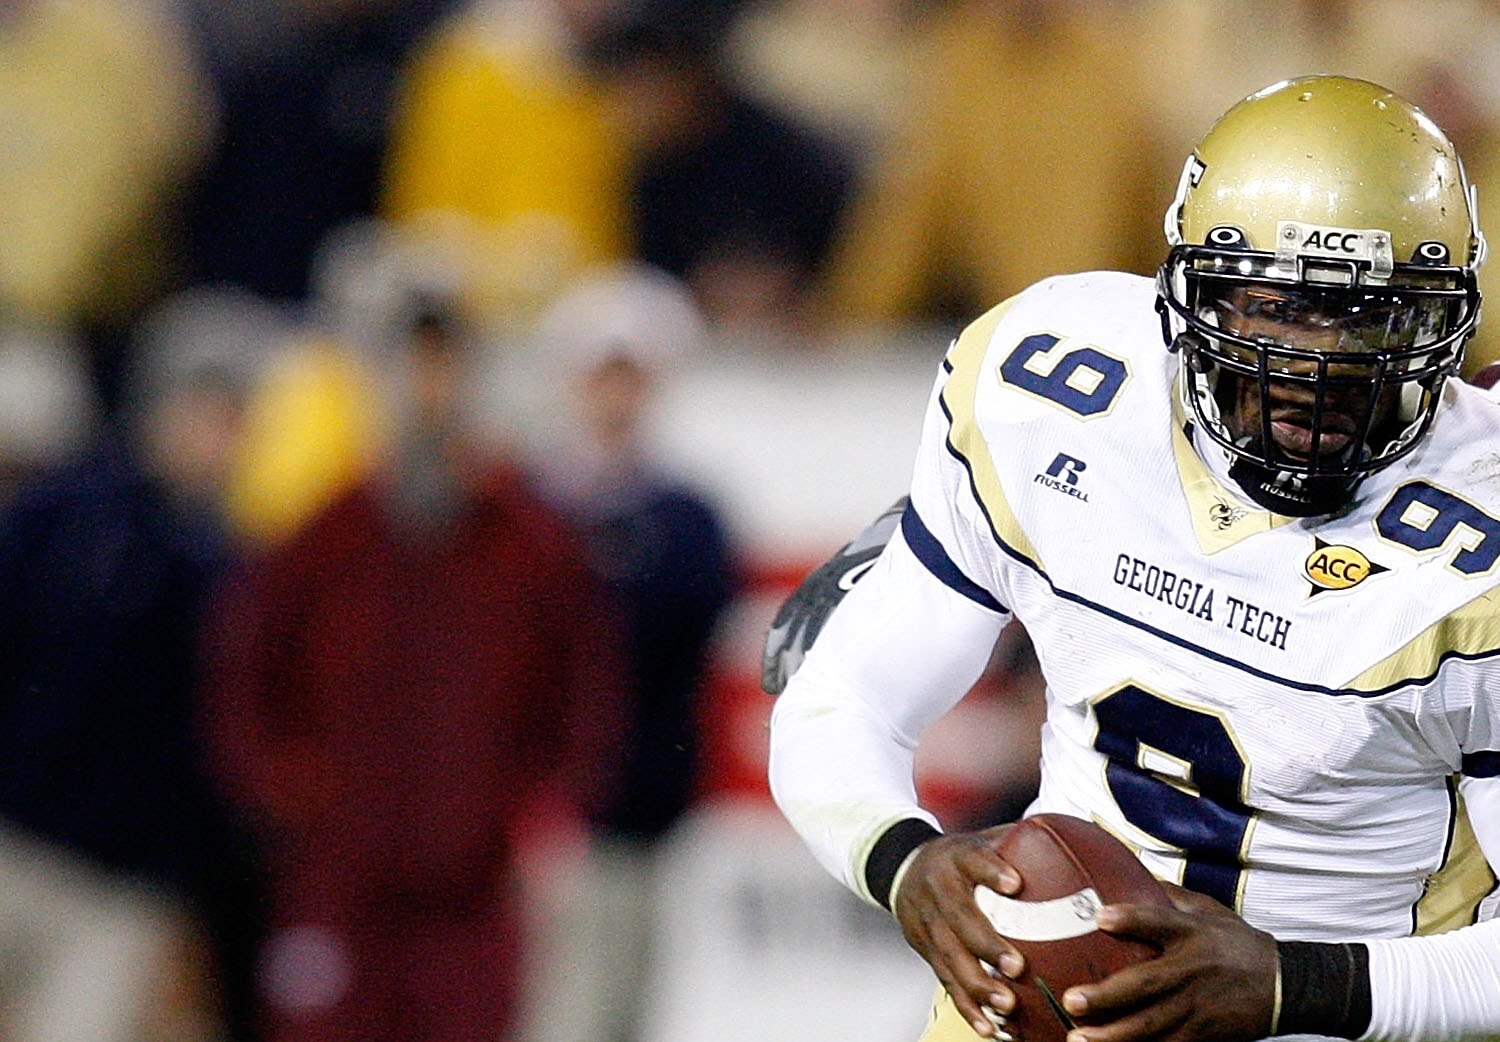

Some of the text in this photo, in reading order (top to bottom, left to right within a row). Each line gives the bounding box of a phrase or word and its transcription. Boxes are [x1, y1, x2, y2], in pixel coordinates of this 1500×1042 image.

[1302, 230, 1358, 252] ACC
[996, 330, 1133, 422] 9
[1033, 474, 1089, 503] RUSSELL
[1309, 554, 1361, 582] ACC
[1113, 553, 1292, 650] GEORGIA TECH
[1088, 679, 1257, 916] 9
